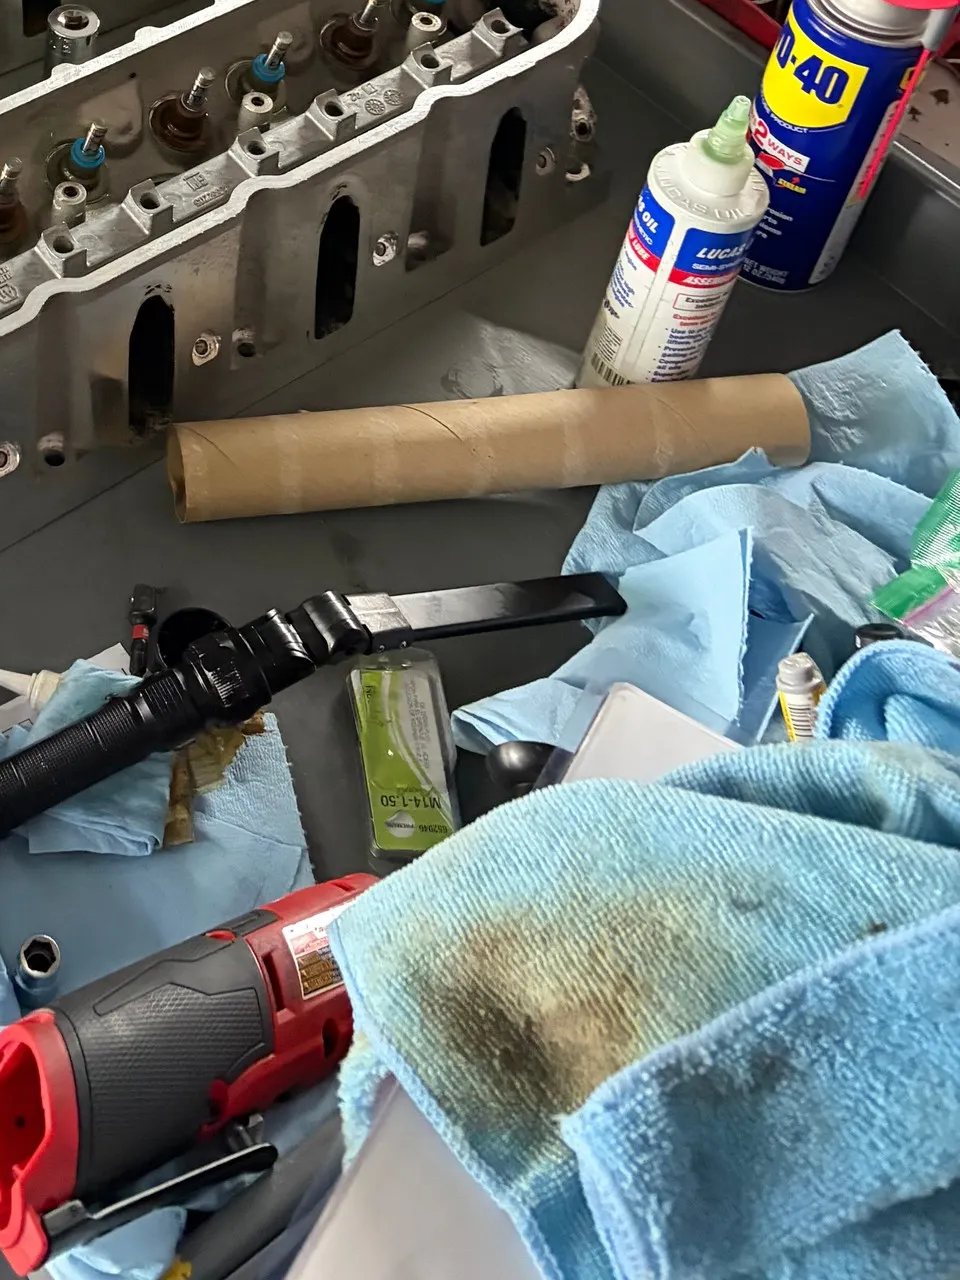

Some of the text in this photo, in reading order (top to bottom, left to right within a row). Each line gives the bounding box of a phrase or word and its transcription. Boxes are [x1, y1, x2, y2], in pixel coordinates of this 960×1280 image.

[776, 21, 850, 106] D-40
[767, 138, 804, 167] WAYS
[380, 794, 442, 809] M14-1.50
